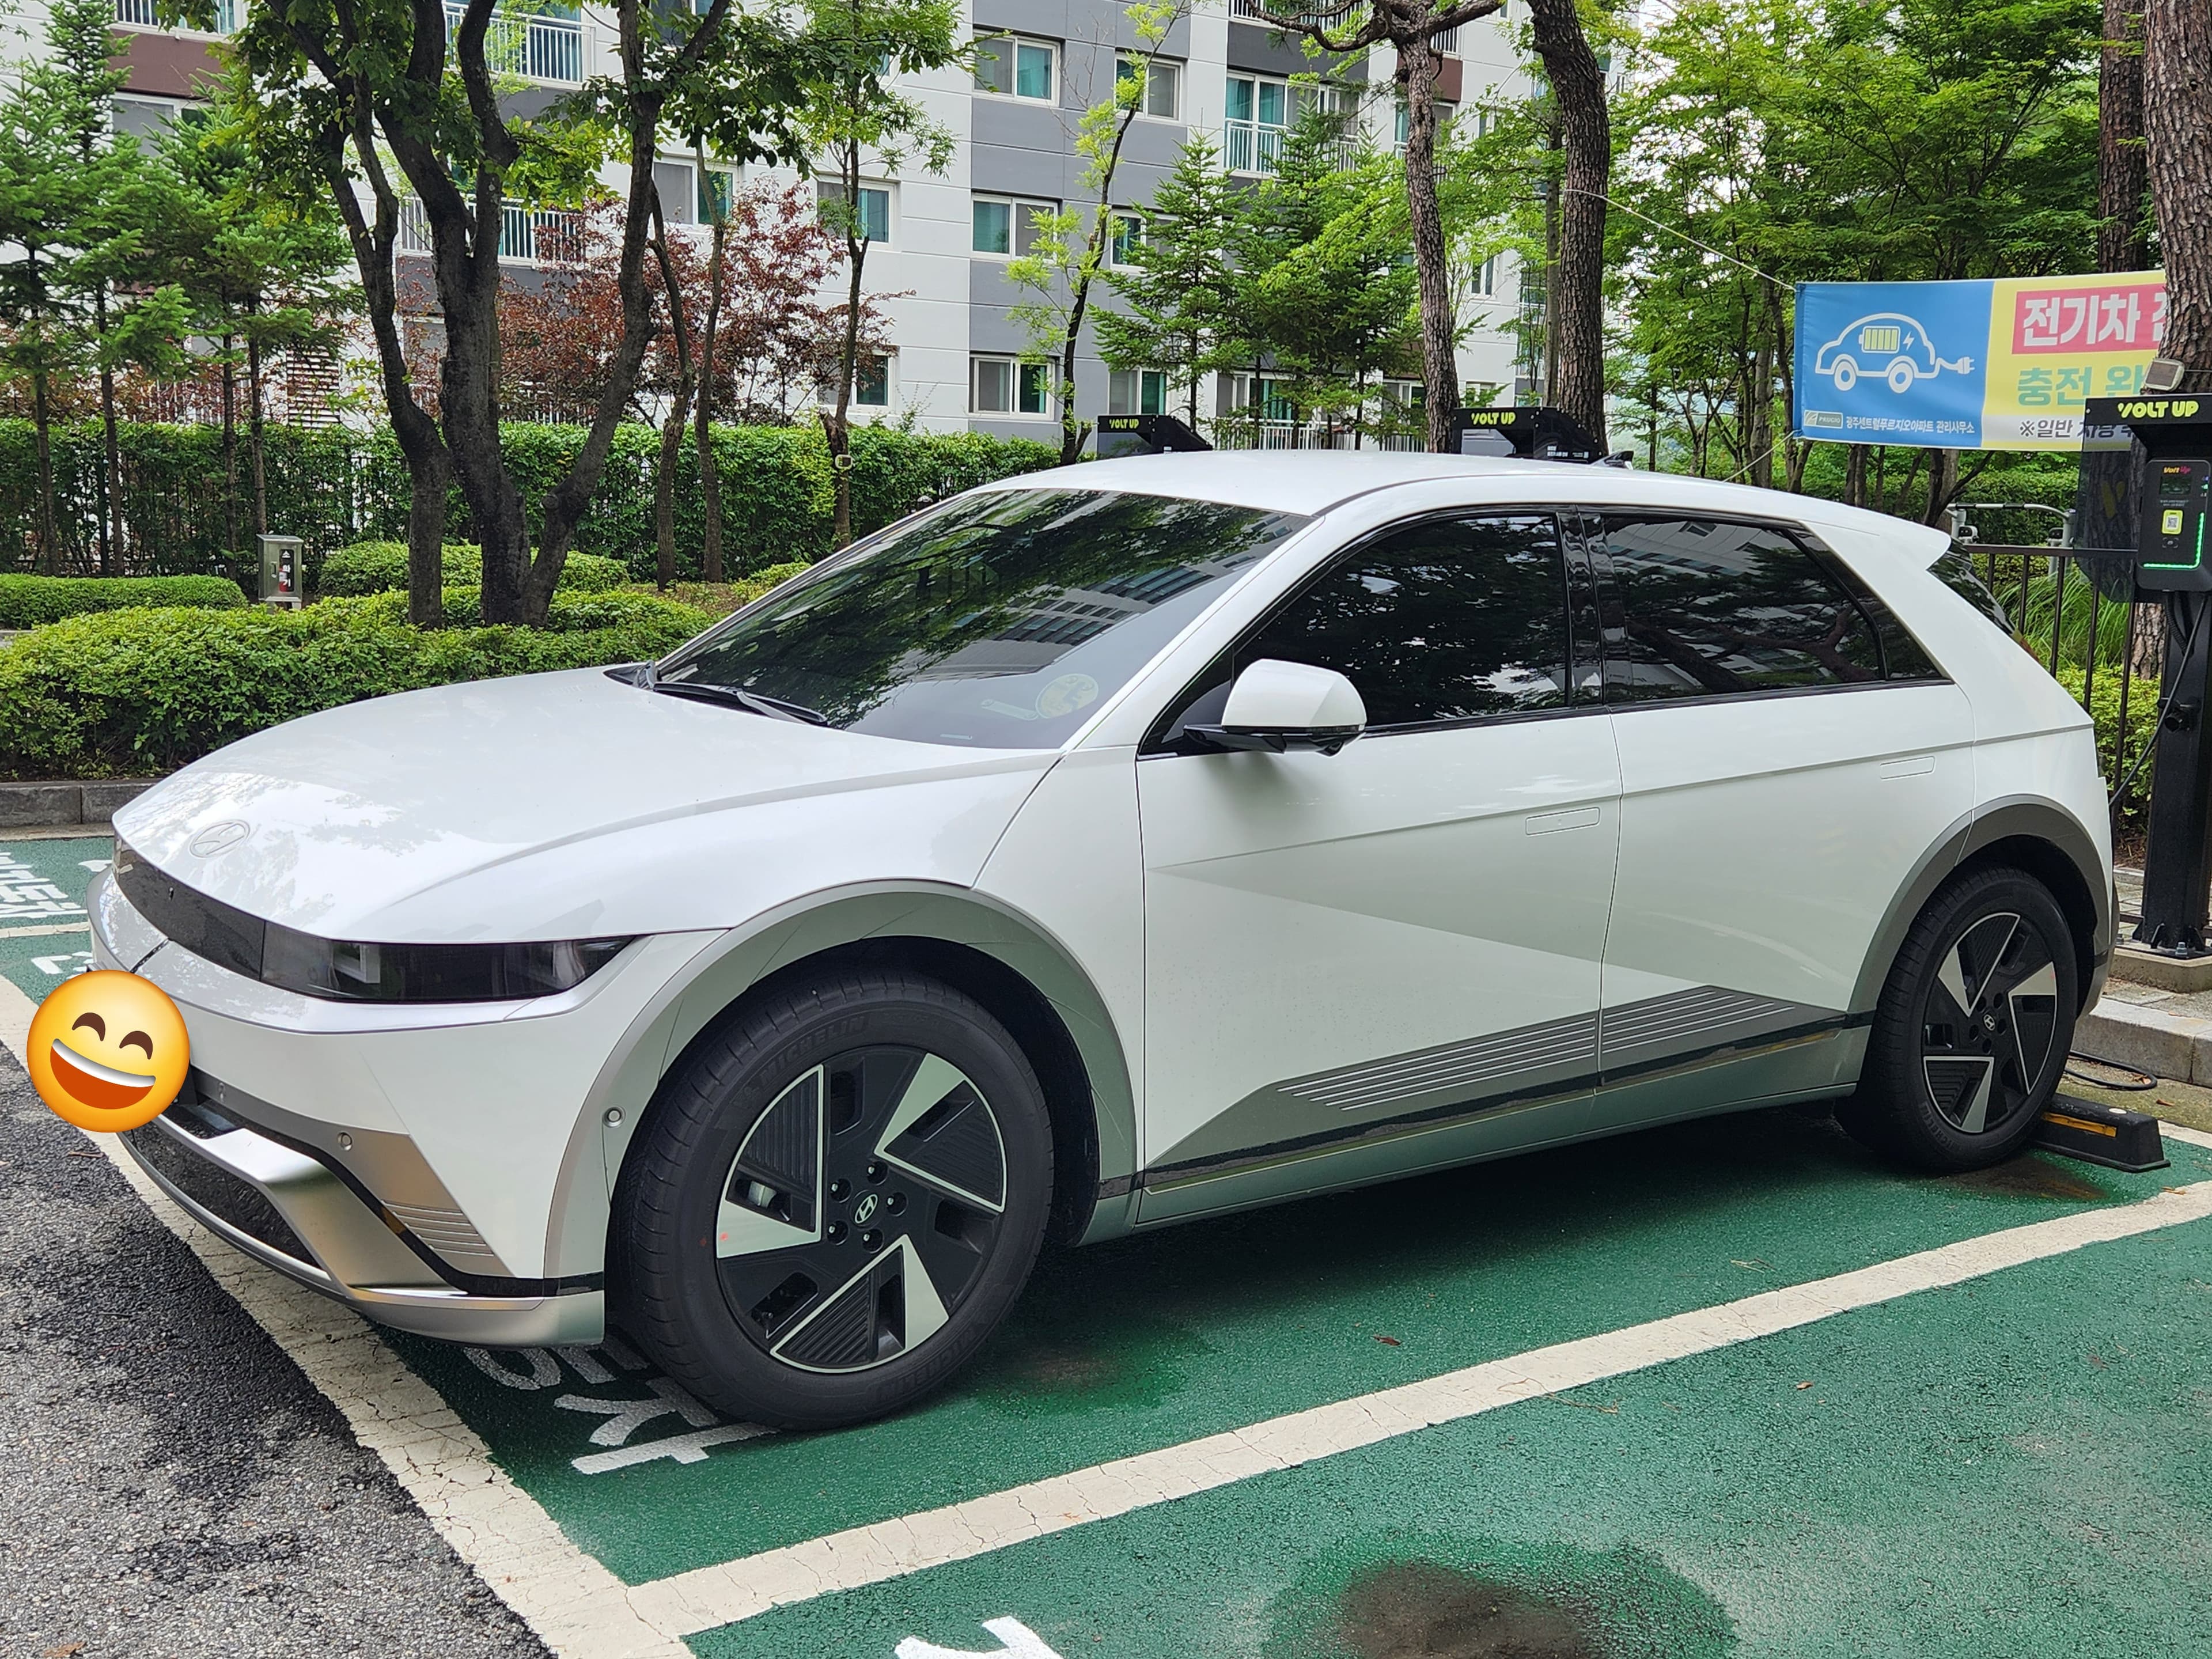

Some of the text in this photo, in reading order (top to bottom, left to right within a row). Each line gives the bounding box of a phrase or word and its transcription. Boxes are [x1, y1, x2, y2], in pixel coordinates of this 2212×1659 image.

[2022, 293, 2141, 347] 전기차
[2017, 366, 2093, 406] 충전
[2118, 400, 2199, 418] VOLT UP
[1109, 419, 1139, 429] VOLT UP
[1471, 412, 1516, 425] VOLT UP
[1936, 420, 1975, 434] 관리사무소
